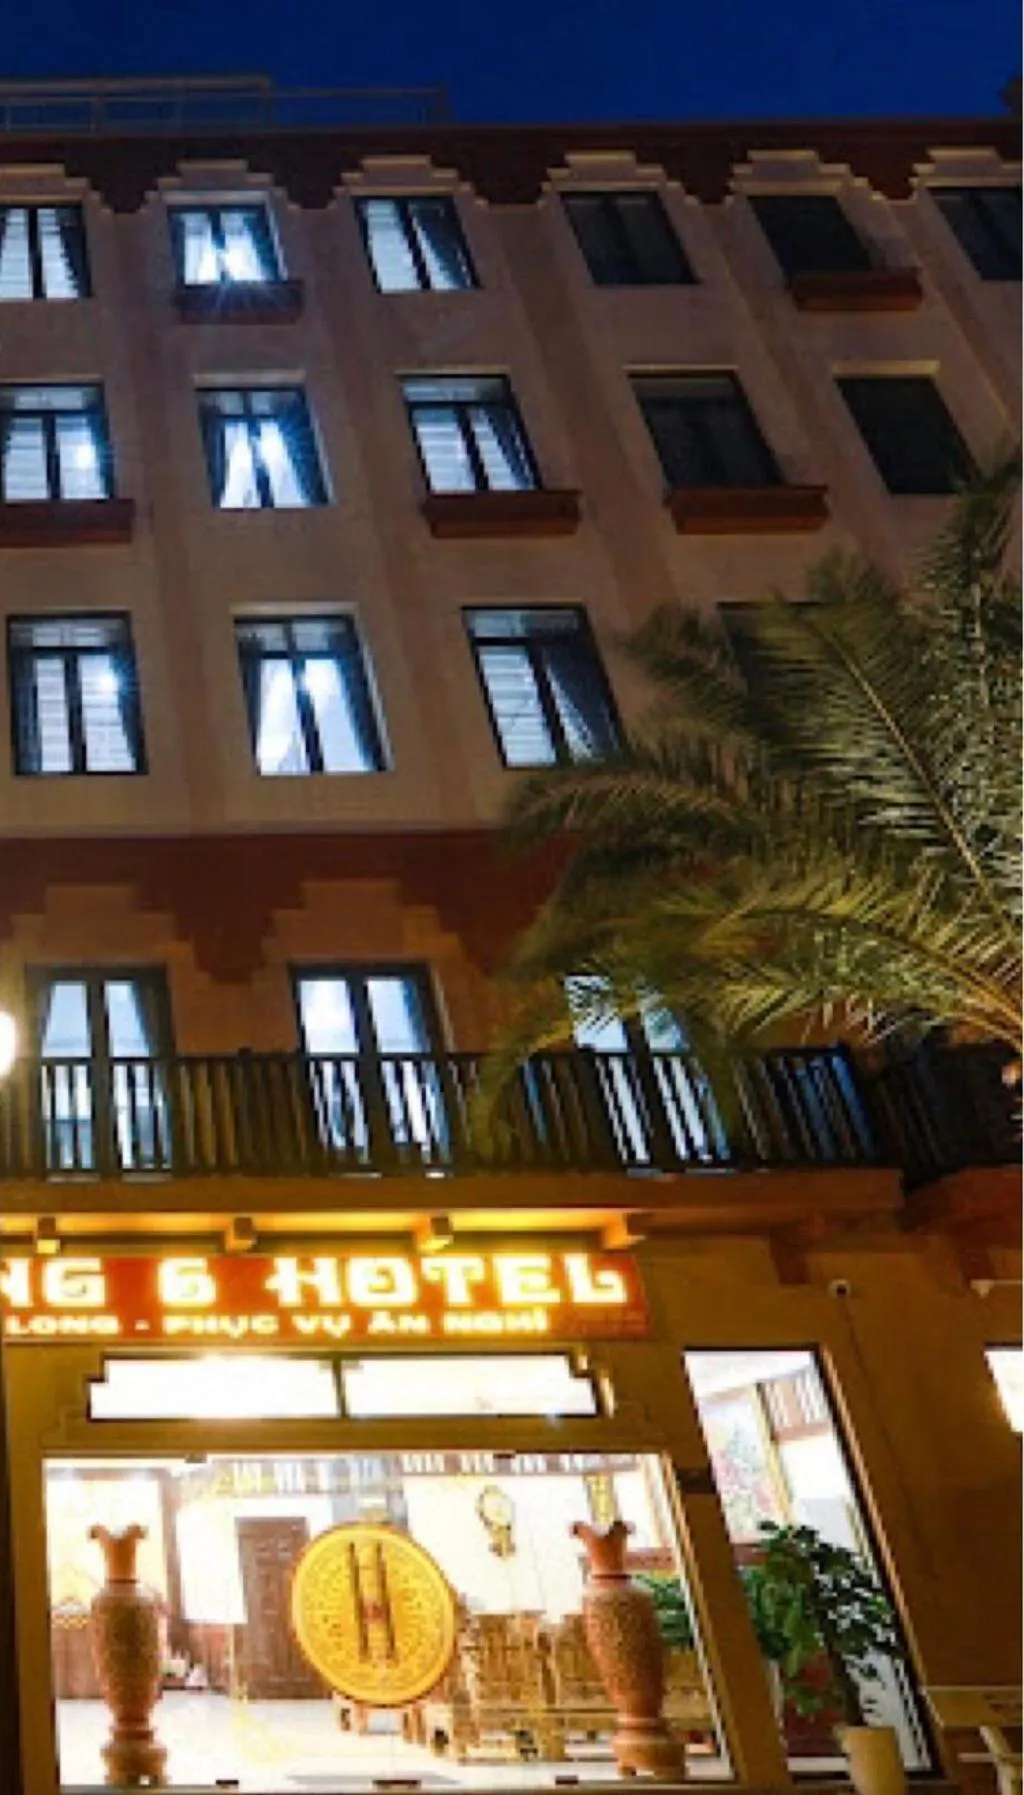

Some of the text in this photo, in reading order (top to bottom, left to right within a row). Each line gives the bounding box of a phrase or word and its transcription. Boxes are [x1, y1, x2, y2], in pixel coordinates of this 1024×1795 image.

[157, 1256, 216, 1309] 6
[264, 1254, 628, 1307] HOTEL
[4, 1314, 120, 1336] LONG
